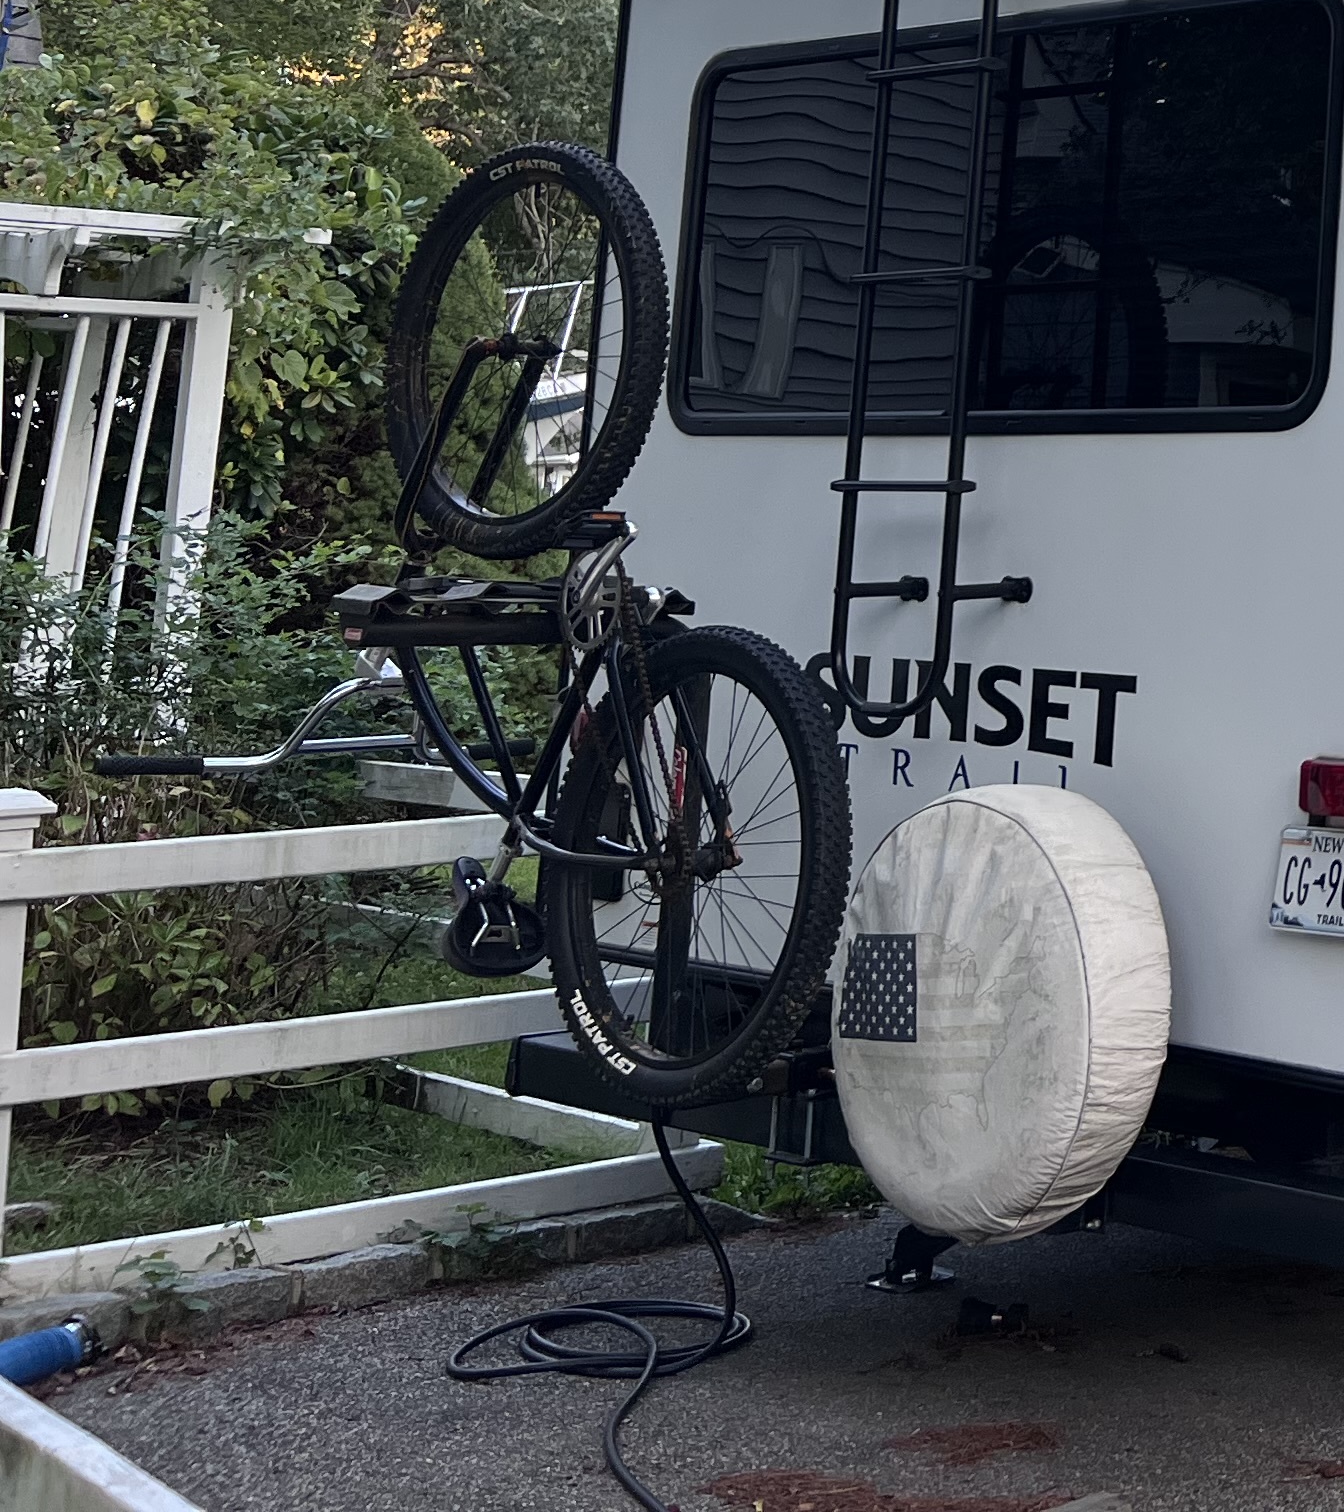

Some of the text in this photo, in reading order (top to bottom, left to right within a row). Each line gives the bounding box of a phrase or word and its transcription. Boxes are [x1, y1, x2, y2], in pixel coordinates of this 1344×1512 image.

[489, 158, 565, 181] CST PATROL
[802, 651, 1138, 768] SUNSET
[569, 988, 637, 1076] CST PATROL
